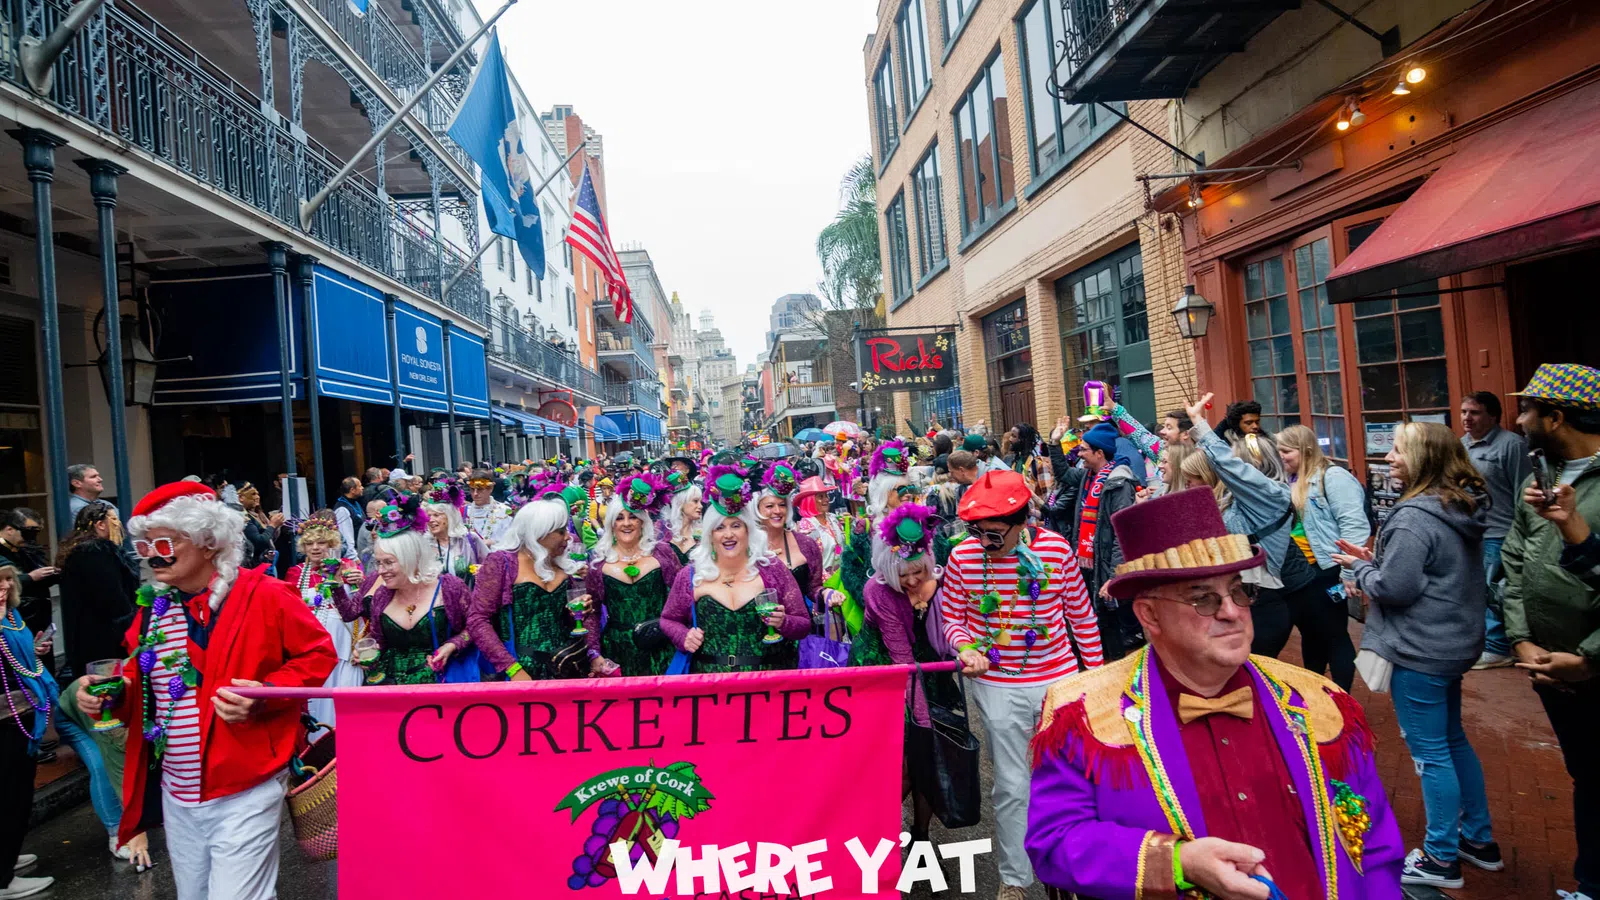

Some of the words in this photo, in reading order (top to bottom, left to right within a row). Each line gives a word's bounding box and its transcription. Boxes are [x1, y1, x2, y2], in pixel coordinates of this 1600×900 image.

[402, 354, 420, 366] ROYAL
[419, 359, 441, 371] SONESTA
[866, 337, 943, 372] Rick's
[409, 372, 419, 380] NEW
[419, 374, 437, 384] ORLEANS
[880, 375, 936, 385] CABARET
[398, 687, 853, 762] CORKETTES
[574, 774, 630, 804] Krewe
[634, 769, 653, 783] of
[656, 772, 695, 797] Cork
